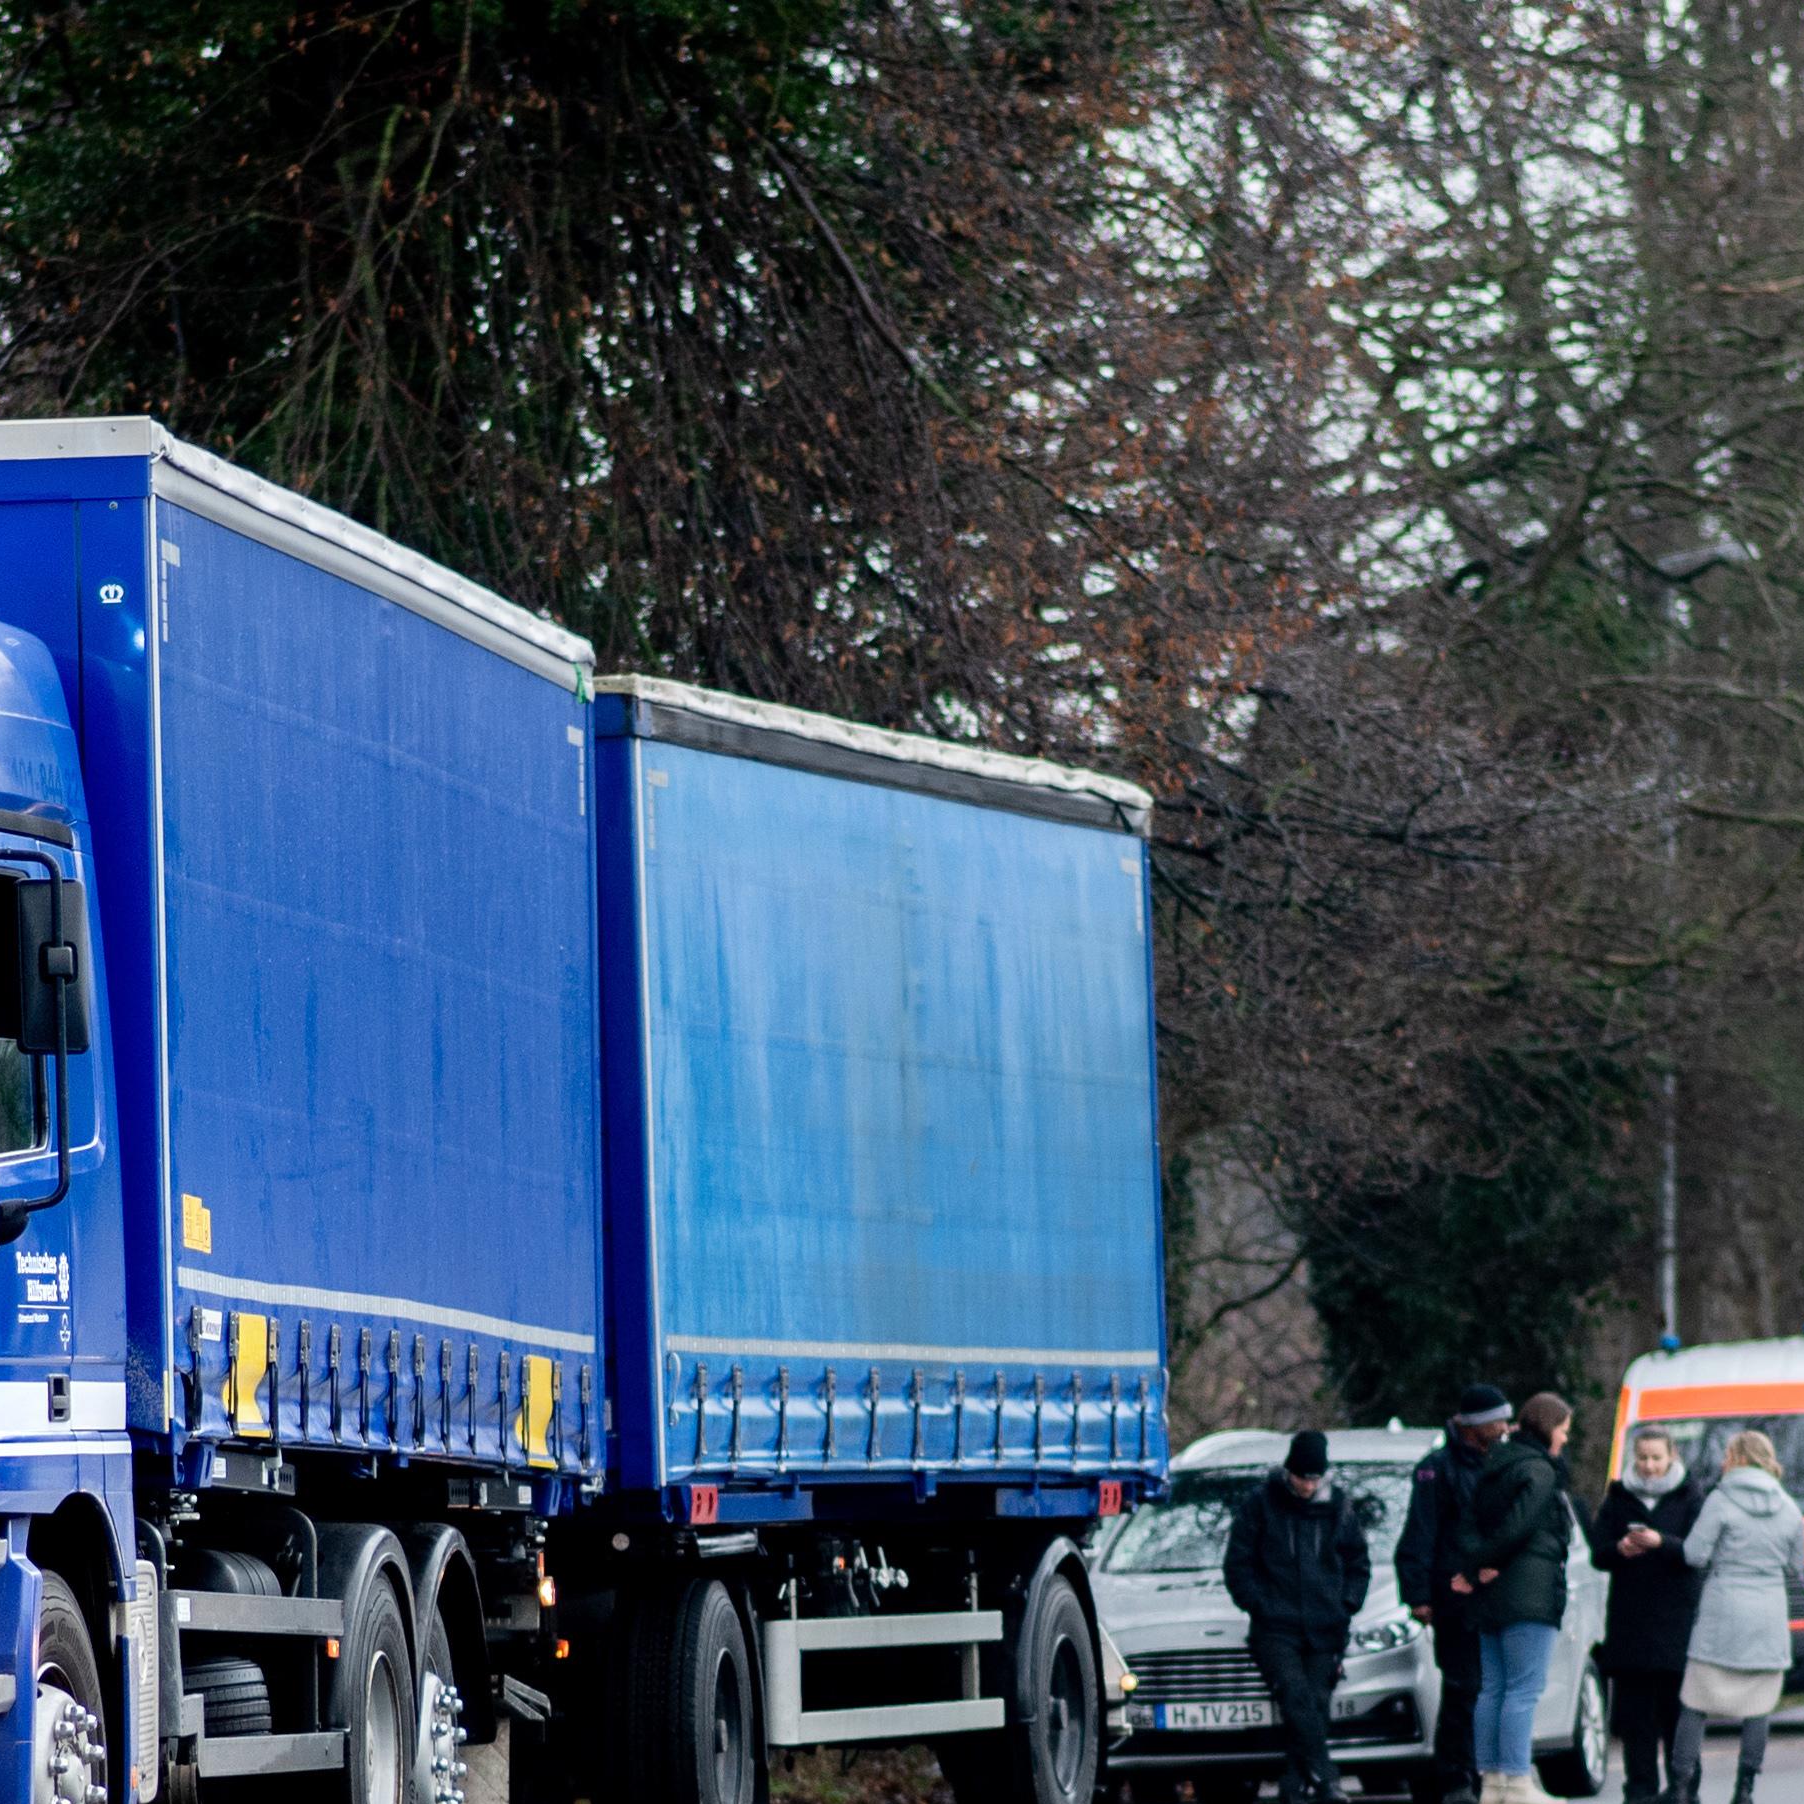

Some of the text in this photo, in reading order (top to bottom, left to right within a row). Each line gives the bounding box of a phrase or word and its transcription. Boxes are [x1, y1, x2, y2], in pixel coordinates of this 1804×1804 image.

[16, 1250, 57, 1275] Technisches
[1174, 1703, 1264, 1725] H TV 215
